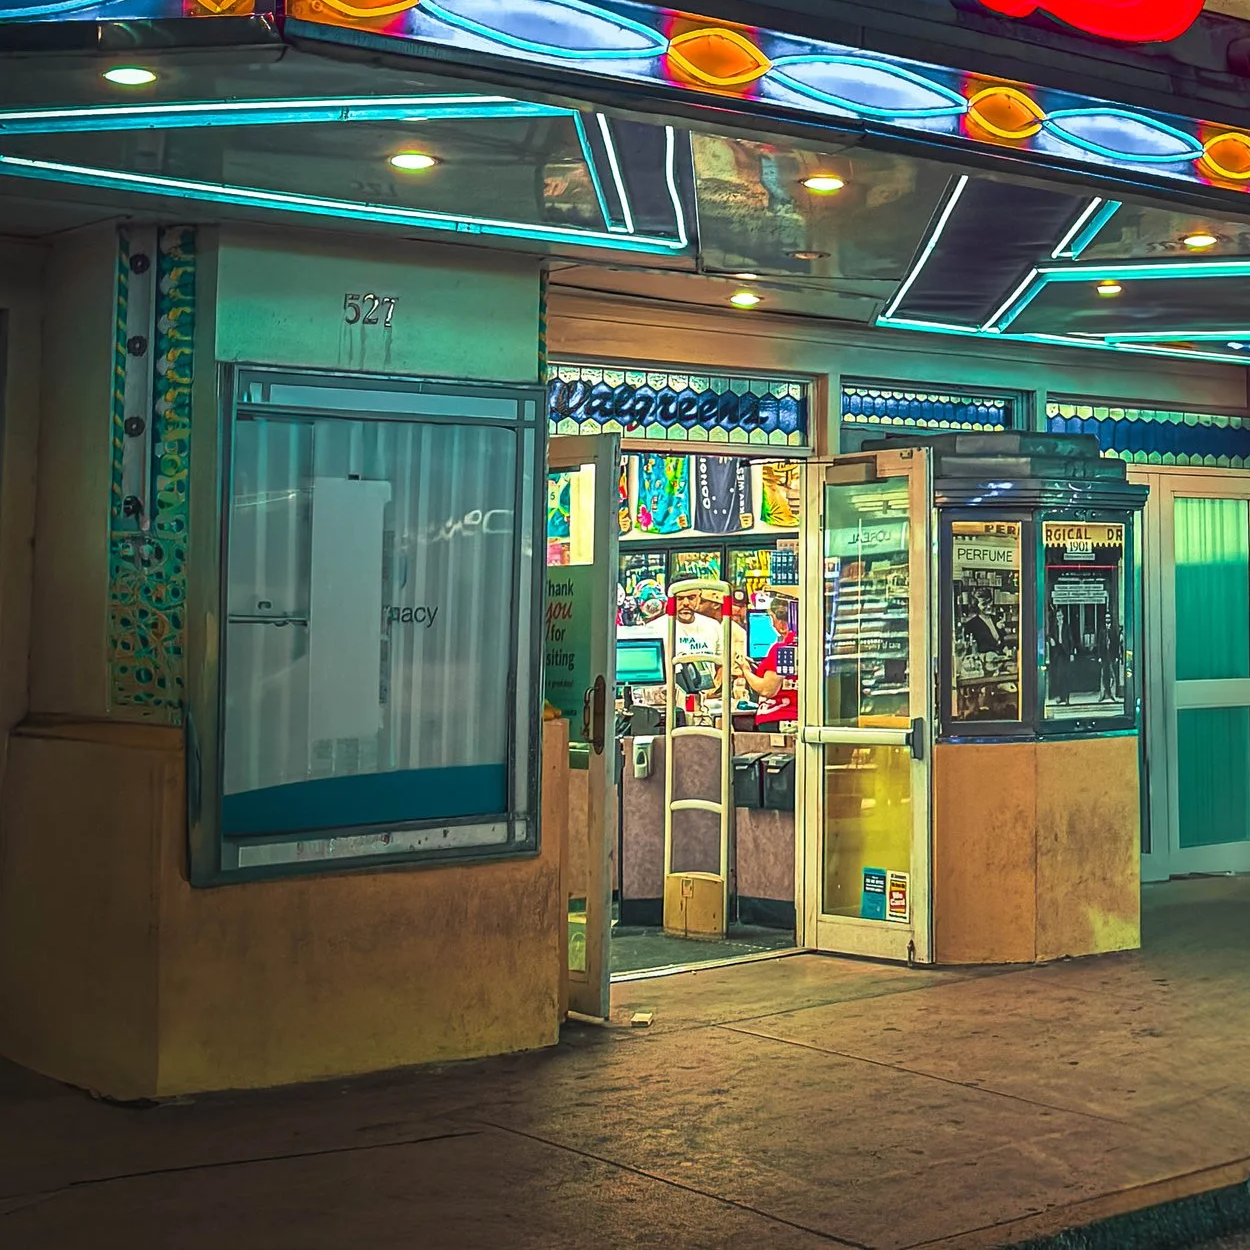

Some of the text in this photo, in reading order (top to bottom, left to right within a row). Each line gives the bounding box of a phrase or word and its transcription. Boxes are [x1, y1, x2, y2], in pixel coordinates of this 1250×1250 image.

[344, 293, 398, 327] 527
[546, 379, 769, 431] Walgreens
[957, 548, 1013, 562] PERFUME
[1069, 540, 1088, 552] 1901
[550, 624, 566, 642] for
